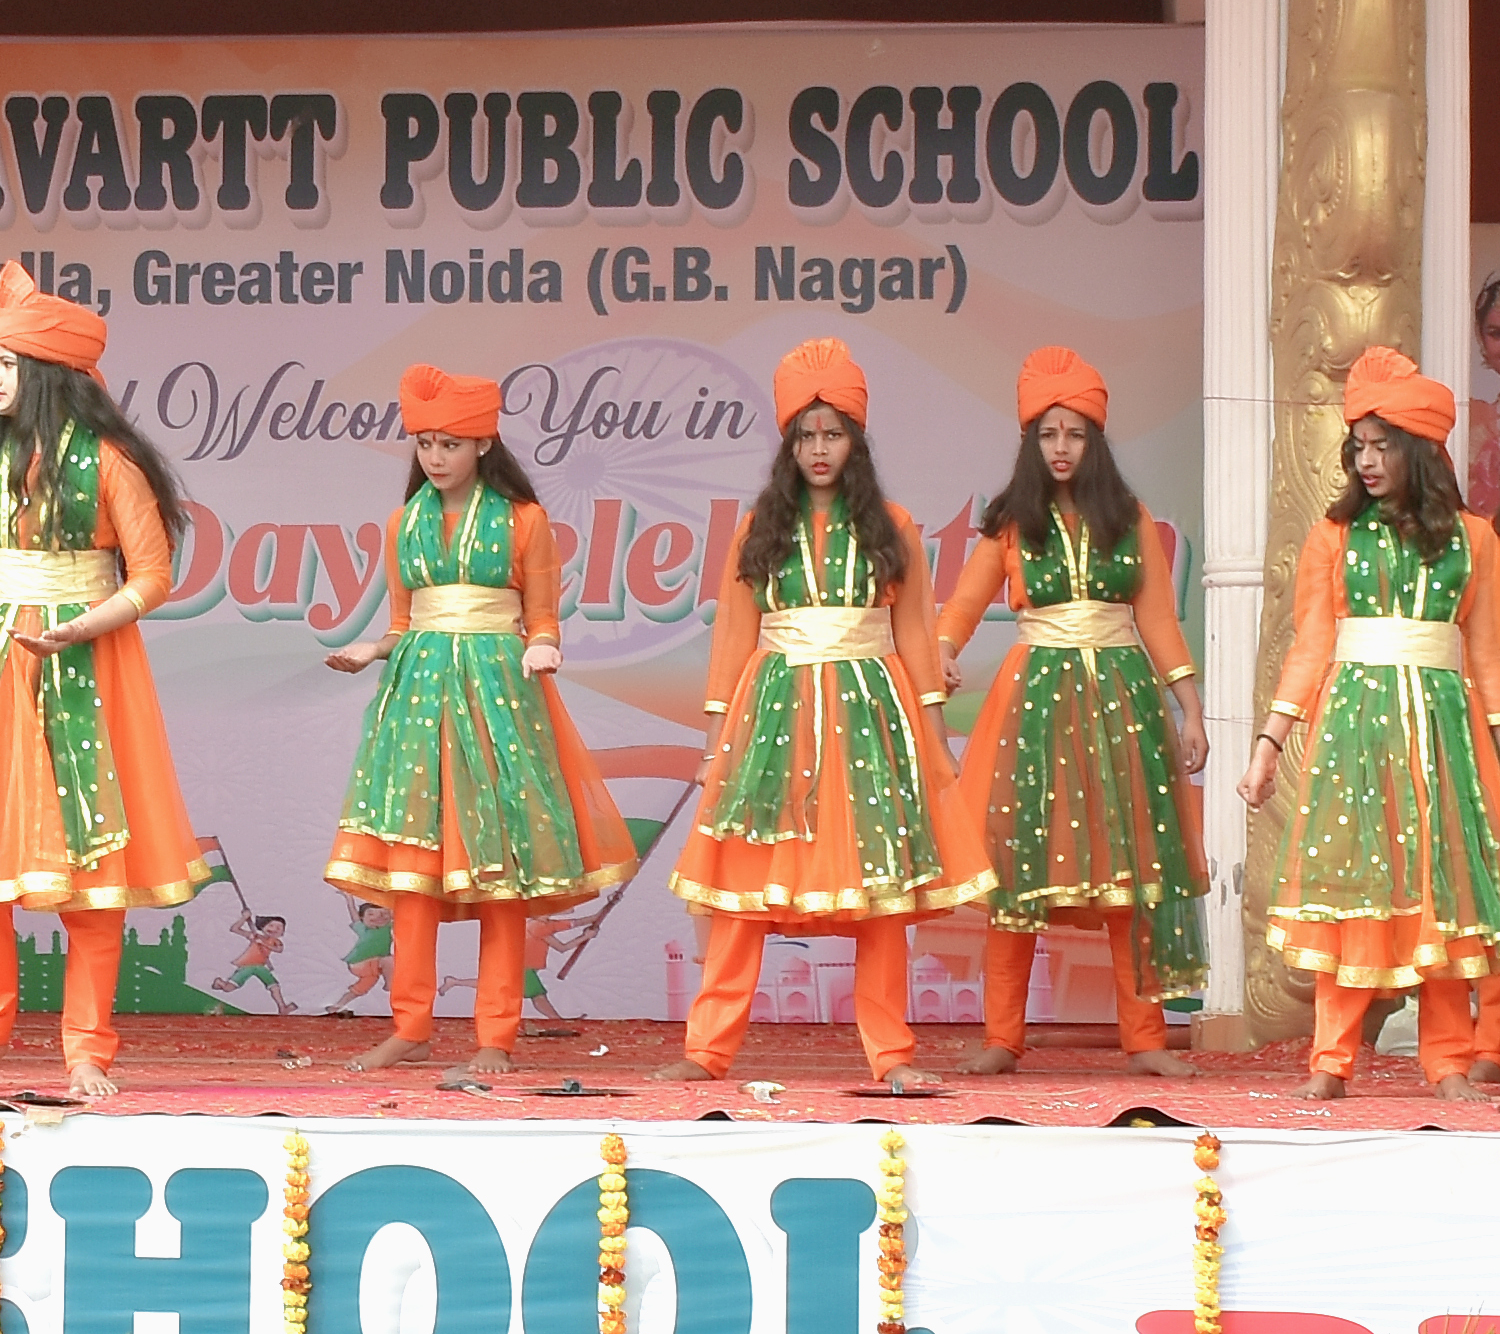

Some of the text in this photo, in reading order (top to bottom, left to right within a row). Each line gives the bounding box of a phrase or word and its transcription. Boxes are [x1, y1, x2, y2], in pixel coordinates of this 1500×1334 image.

[379, 88, 745, 212] PUBLIC
[788, 80, 1200, 209] SCHOOL
[133, 249, 357, 307] Greater
[385, 248, 563, 305] Noida
[588, 246, 728, 316] (G.B.
[754, 244, 968, 315] Nagar)
[157, 361, 406, 462] Welco
[500, 363, 672, 467] You
[684, 386, 758, 441] in
